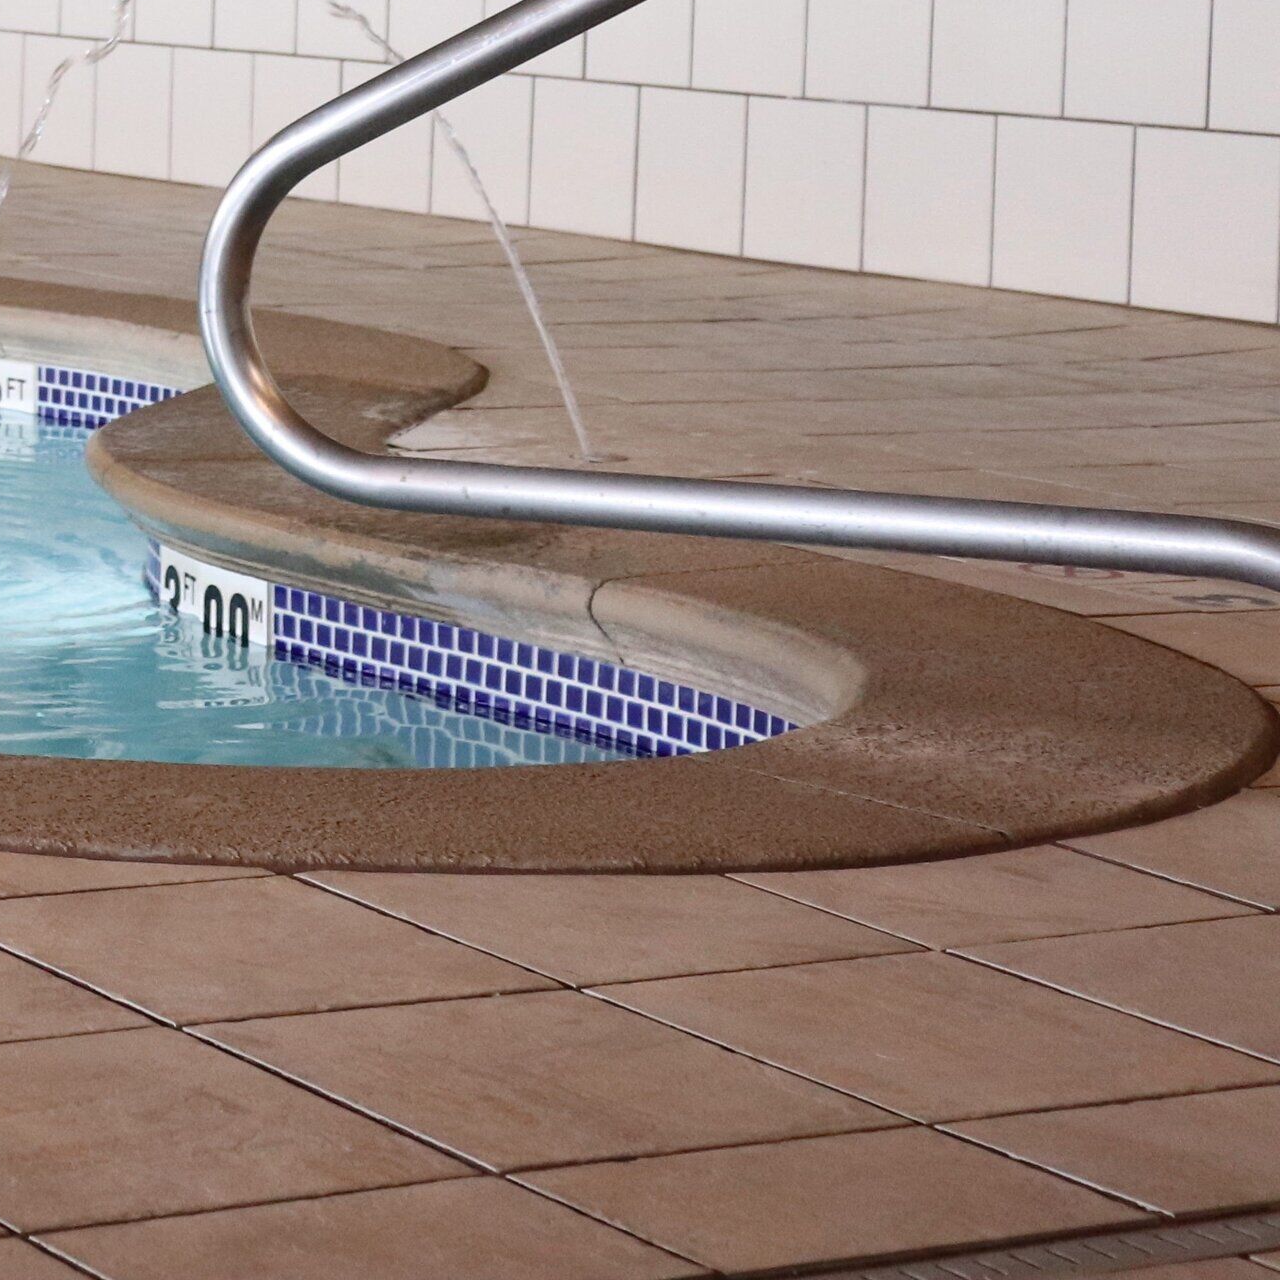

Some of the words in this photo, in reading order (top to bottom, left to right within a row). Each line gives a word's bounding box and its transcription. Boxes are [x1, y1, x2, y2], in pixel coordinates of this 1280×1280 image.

[7, 377, 26, 401] FT
[184, 572, 197, 605] FT
[251, 598, 263, 623] M
